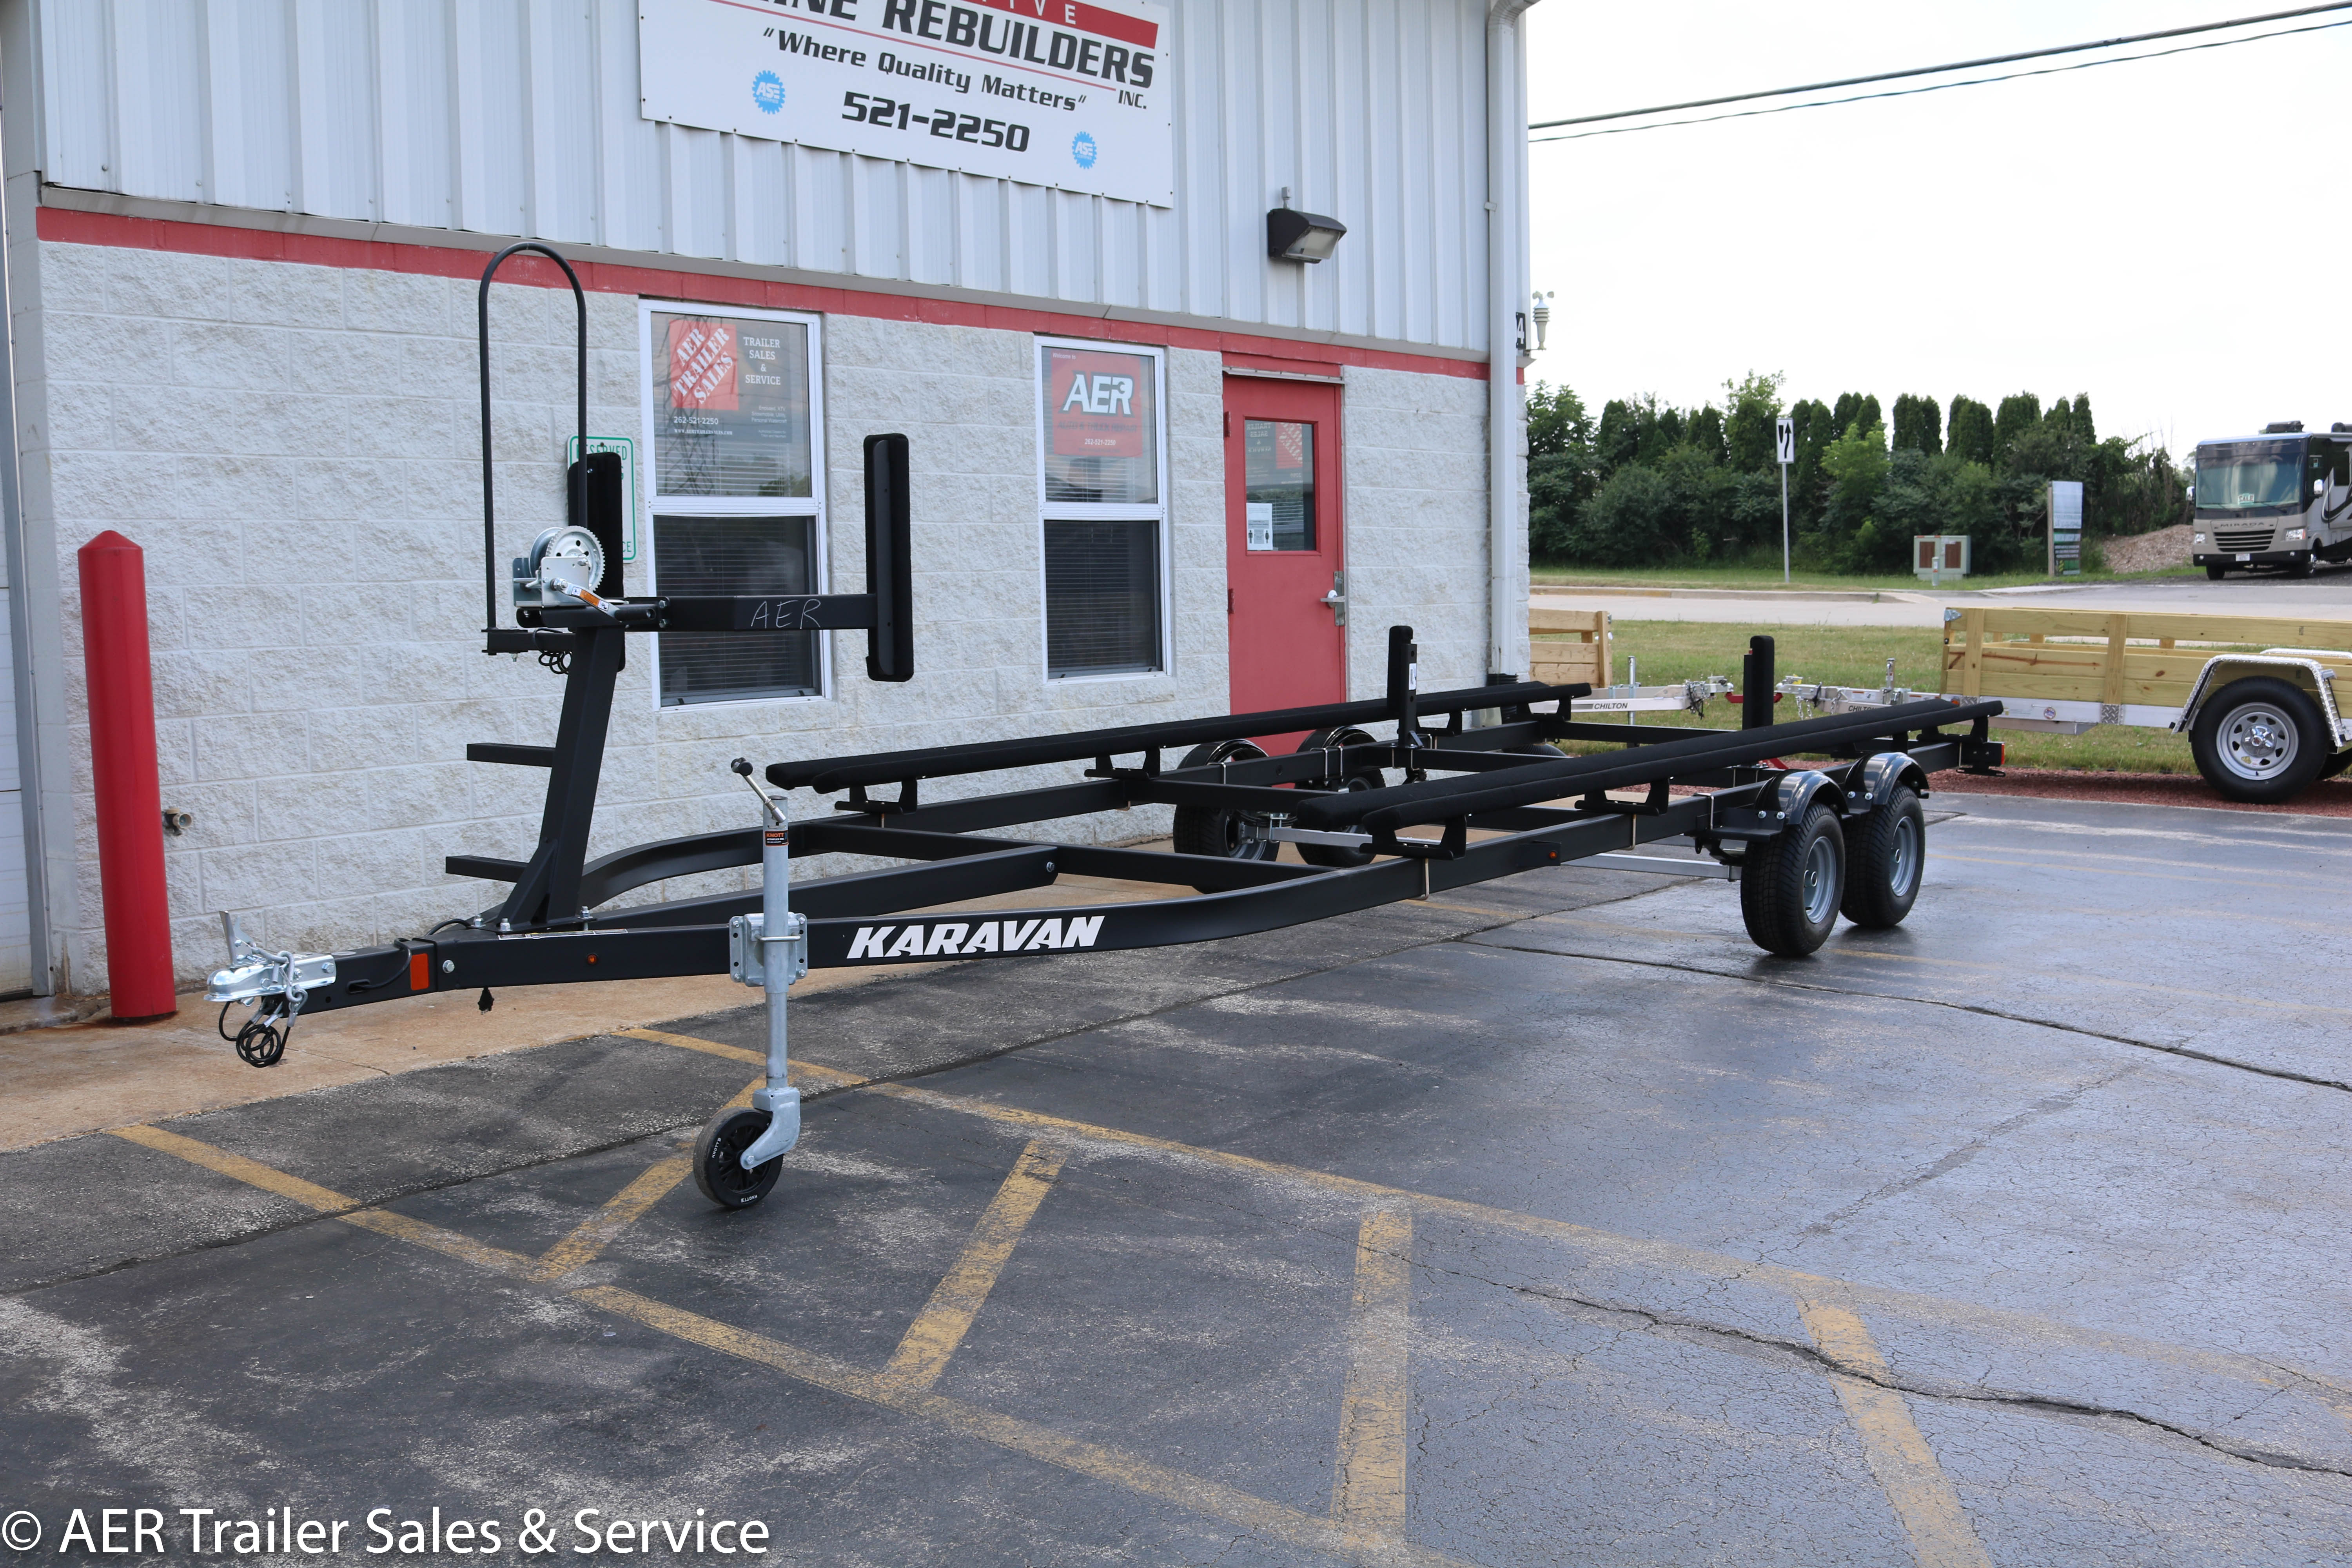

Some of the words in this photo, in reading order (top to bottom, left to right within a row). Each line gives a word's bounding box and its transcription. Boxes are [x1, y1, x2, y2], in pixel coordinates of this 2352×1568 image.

[882, 0, 1154, 89] REBUILDERS
[763, 27, 866, 67] "Where
[878, 52, 971, 94] Quality
[981, 74, 1087, 111] Matters"
[756, 82, 780, 100] ASE
[1118, 89, 1147, 109] INC.
[842, 91, 1030, 152] 521-2250
[1075, 141, 1093, 157] ASE
[677, 328, 705, 367] AER
[743, 336, 781, 348] TRAILER
[749, 349, 776, 360] SALES
[673, 328, 730, 397] TRAILER
[760, 363, 767, 372] &
[694, 352, 733, 405] SALES
[745, 374, 781, 385] SERVICE
[1063, 374, 1133, 415] AER
[674, 416, 719, 425] 262-521-2250
[577, 444, 627, 461] SERVED
[751, 599, 821, 630] AER
[846, 915, 1105, 959] KARAVAN
